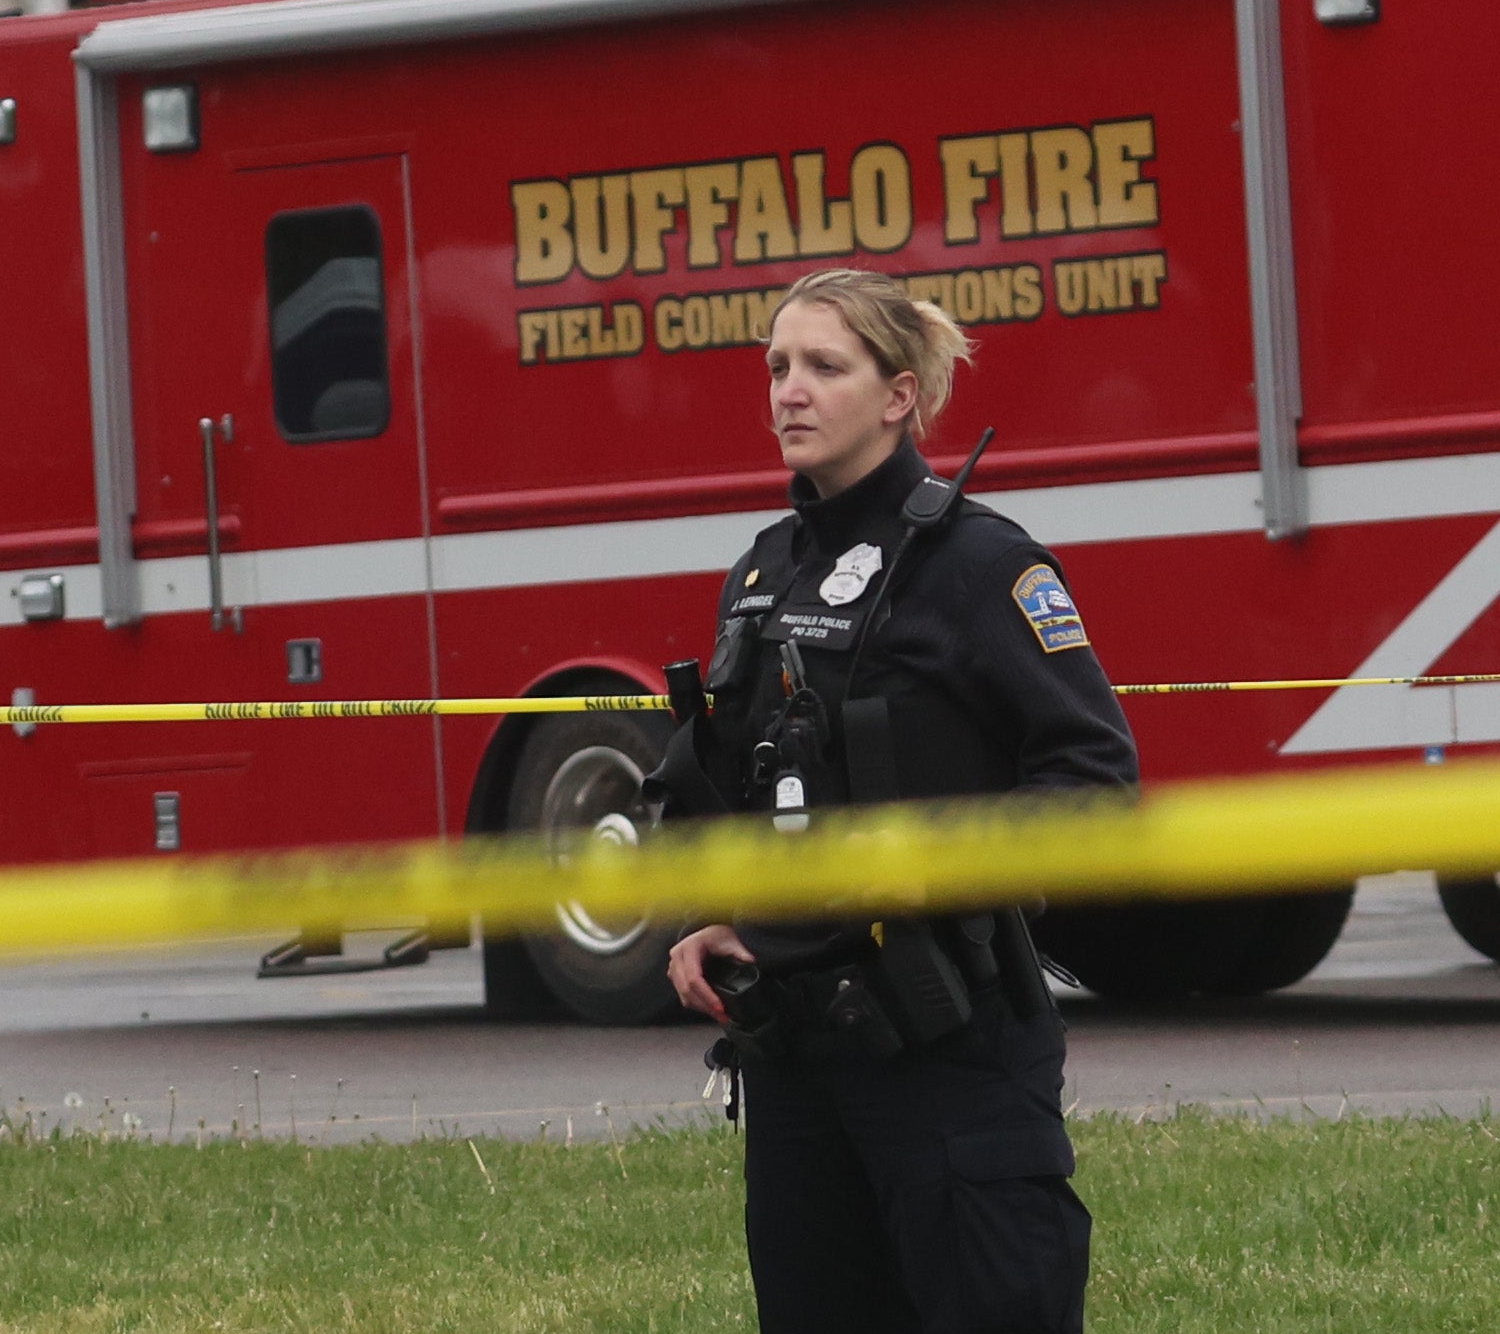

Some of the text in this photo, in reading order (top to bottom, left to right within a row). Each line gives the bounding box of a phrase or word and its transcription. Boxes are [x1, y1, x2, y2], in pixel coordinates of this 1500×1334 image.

[509, 114, 1161, 287] BUFFALO FIRE
[516, 301, 645, 364] FIELD
[1053, 250, 1166, 316] UNIT
[780, 613, 853, 630] BUFFALO POLICE
